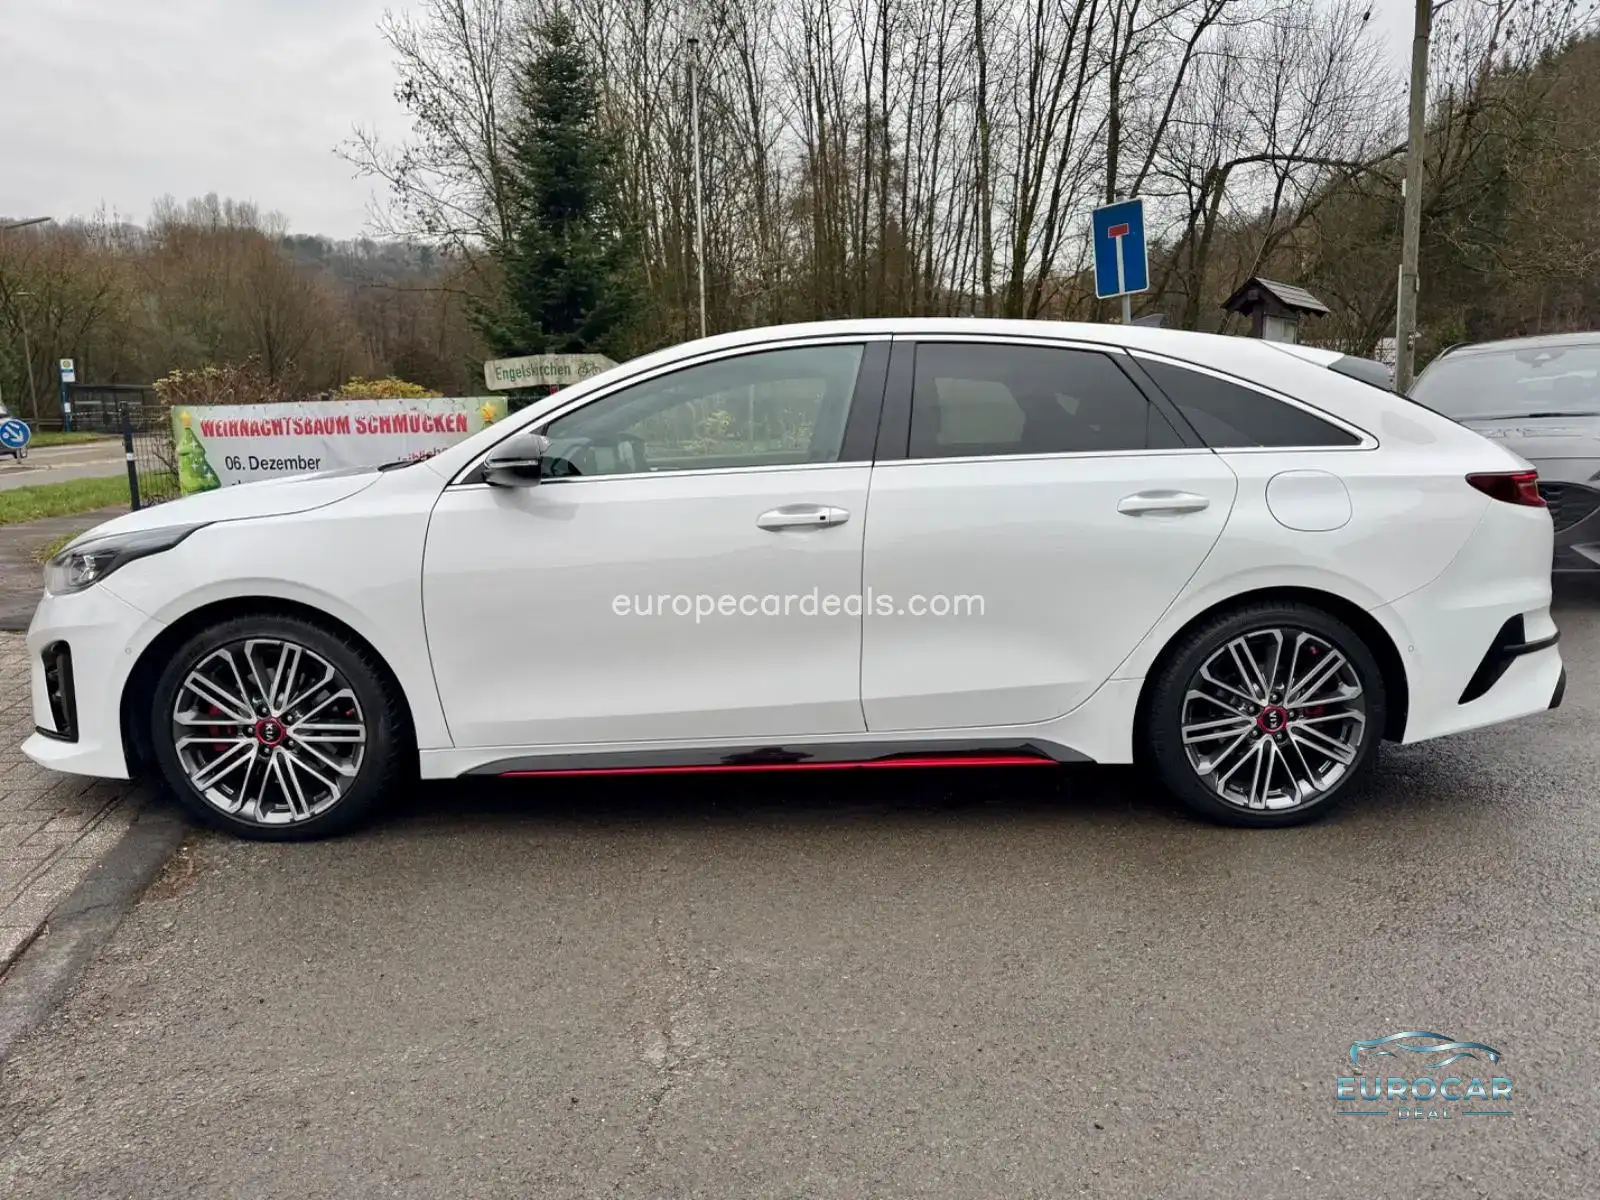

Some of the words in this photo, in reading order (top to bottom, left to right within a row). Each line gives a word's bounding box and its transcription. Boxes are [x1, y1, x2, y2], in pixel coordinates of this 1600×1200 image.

[495, 364, 571, 382] Engelskirchen
[200, 416, 350, 437] WEIHNACHTSBAUM
[225, 456, 246, 471] 06.
[248, 455, 320, 471] Dezember
